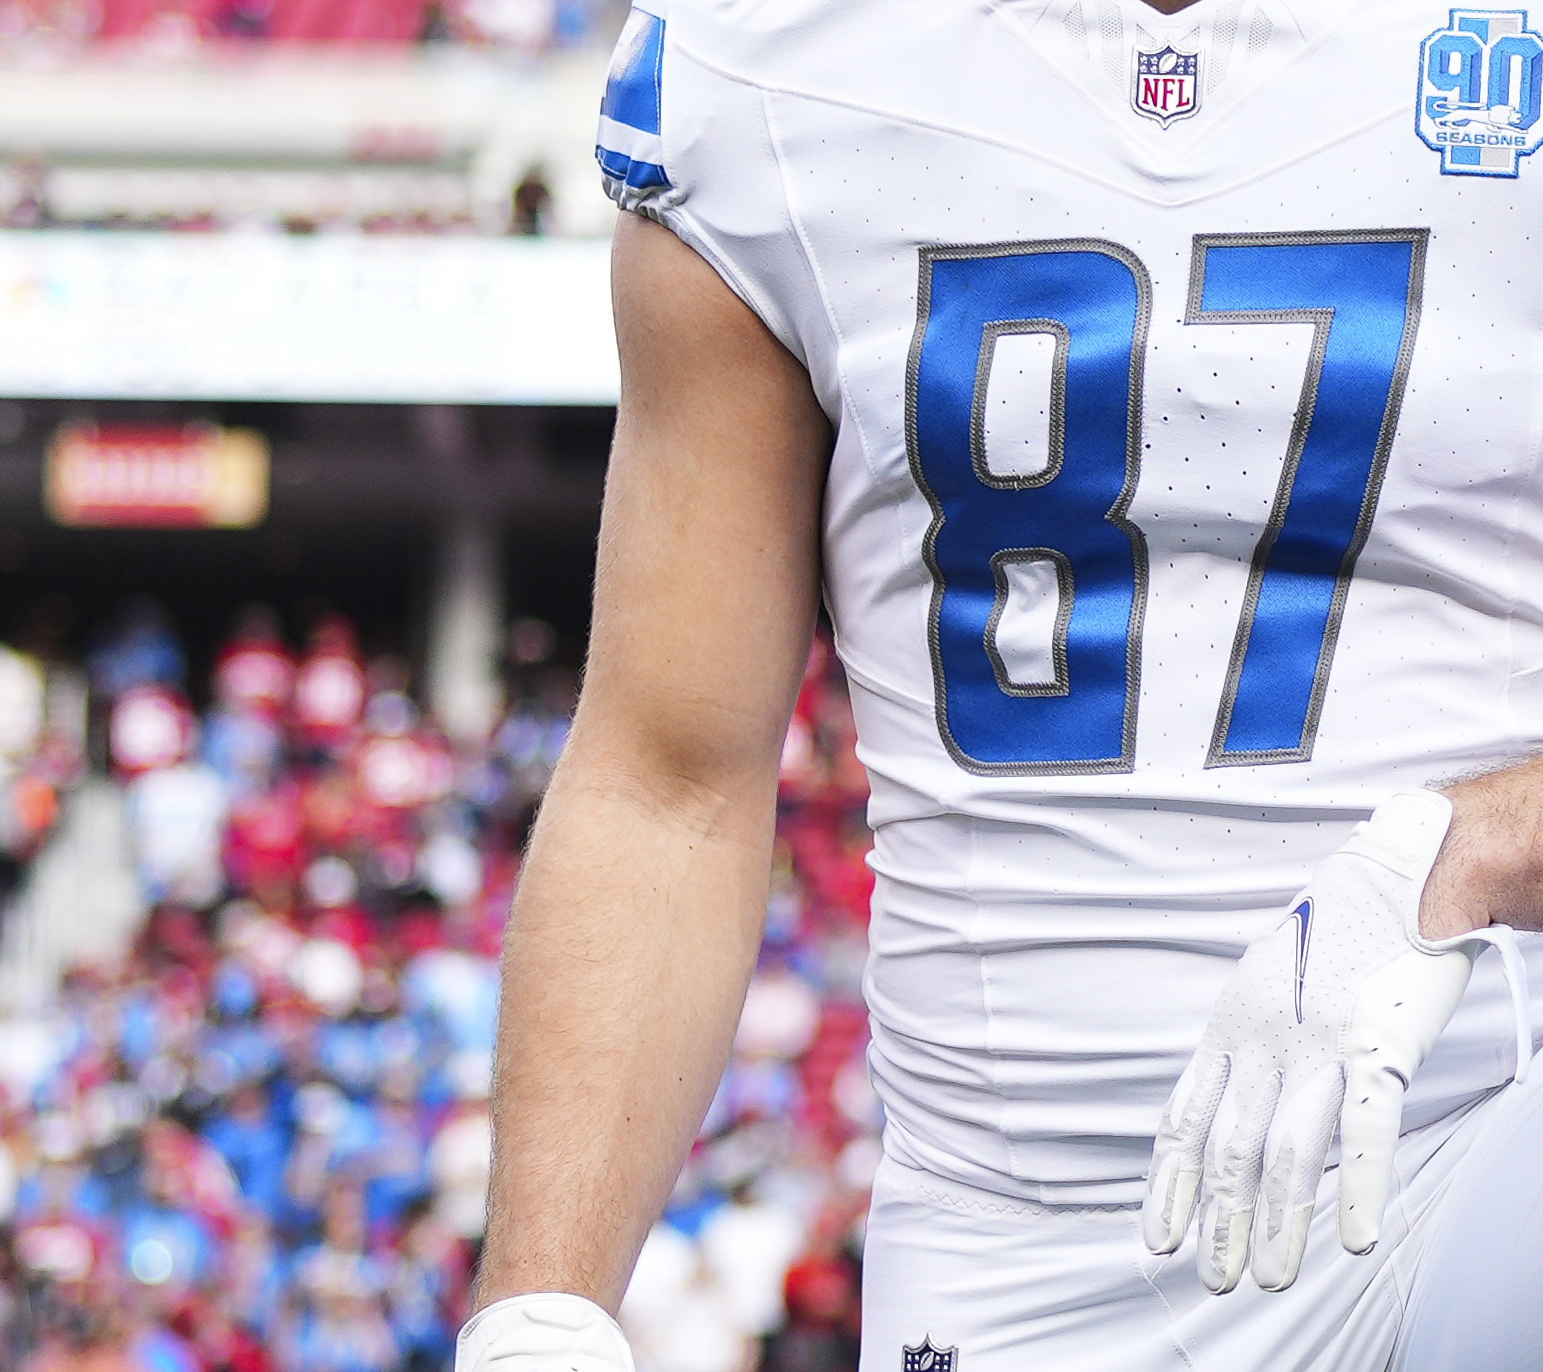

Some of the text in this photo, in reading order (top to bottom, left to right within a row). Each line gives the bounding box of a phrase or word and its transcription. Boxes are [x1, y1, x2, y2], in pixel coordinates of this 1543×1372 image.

[1142, 78, 1190, 111] NFL
[1426, 34, 1543, 130] 90
[1436, 132, 1527, 147] SEASONS
[906, 228, 1432, 777] 87
